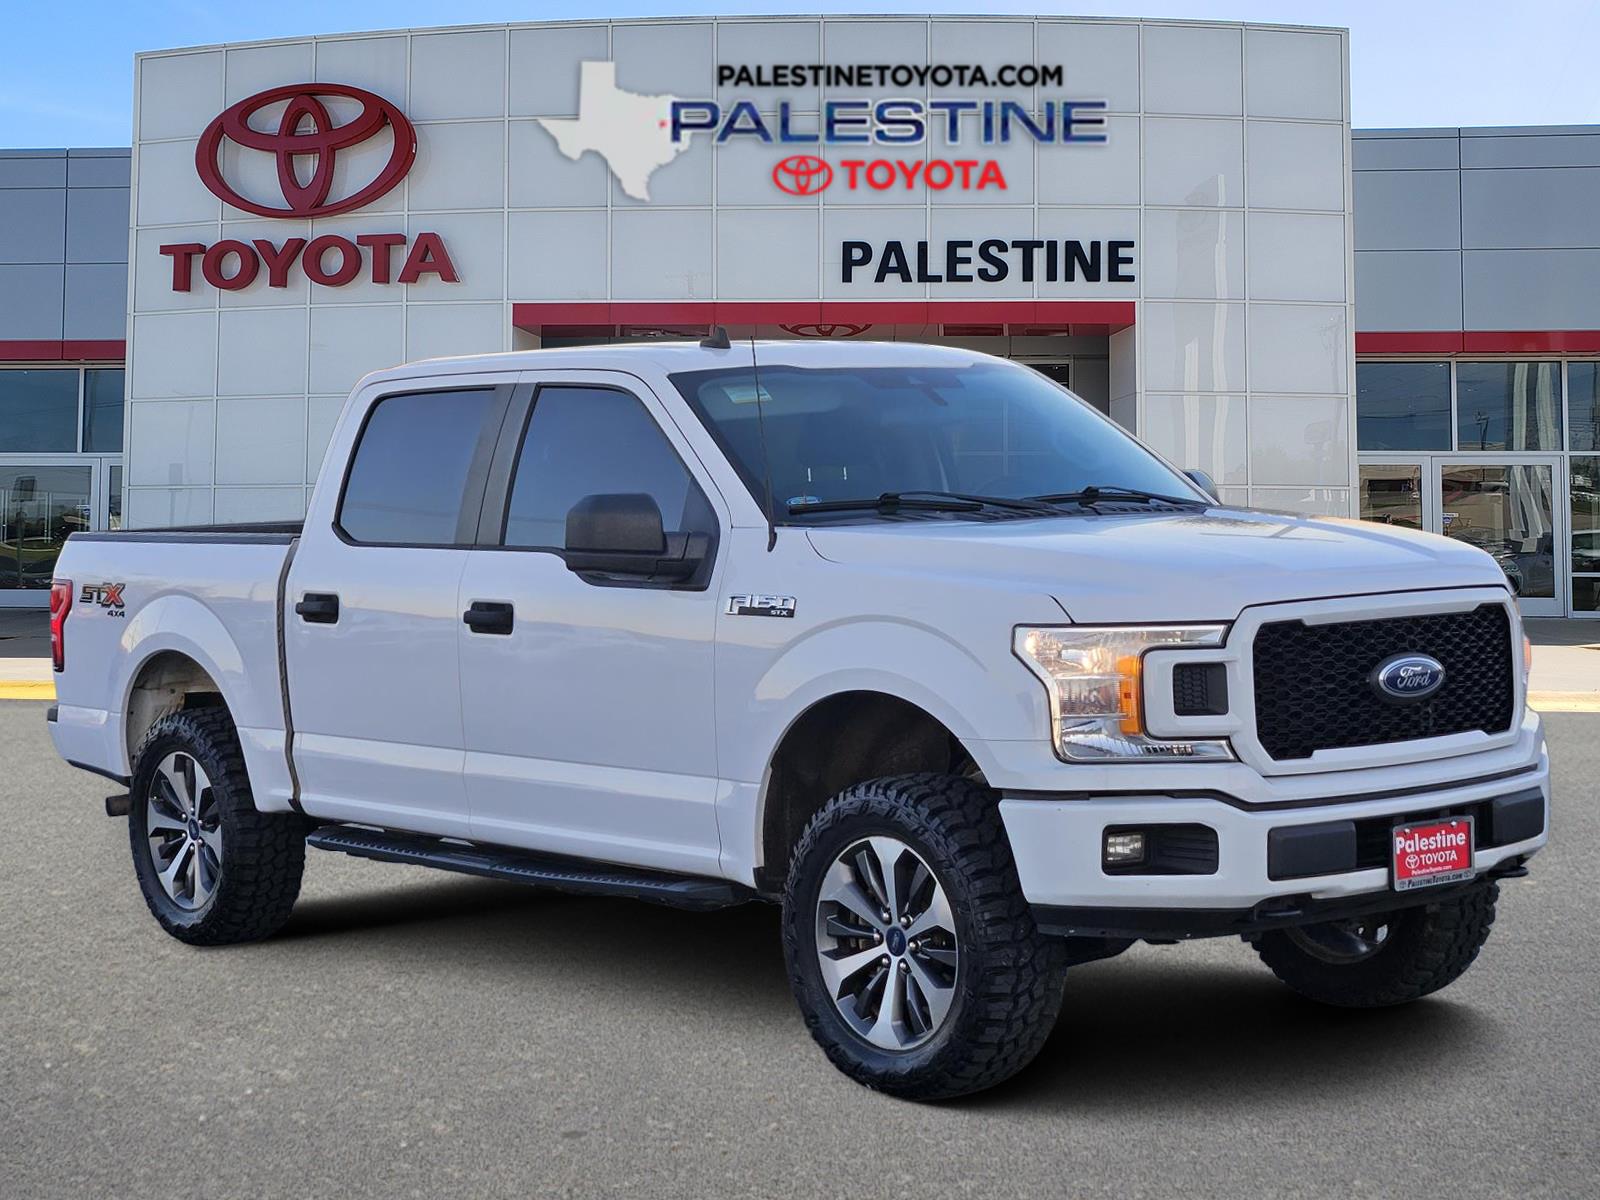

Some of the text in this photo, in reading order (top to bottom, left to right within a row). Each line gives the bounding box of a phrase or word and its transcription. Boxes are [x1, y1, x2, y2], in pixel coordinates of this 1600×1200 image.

[159, 232, 461, 292] TOYOTA
[841, 240, 1136, 283] PALESTINE
[80, 582, 126, 608] STX
[770, 609, 788, 617] STX
[1397, 666, 1431, 688] Ford
[1396, 829, 1466, 855] Palestine
[1420, 850, 1458, 865] TOYOTA
